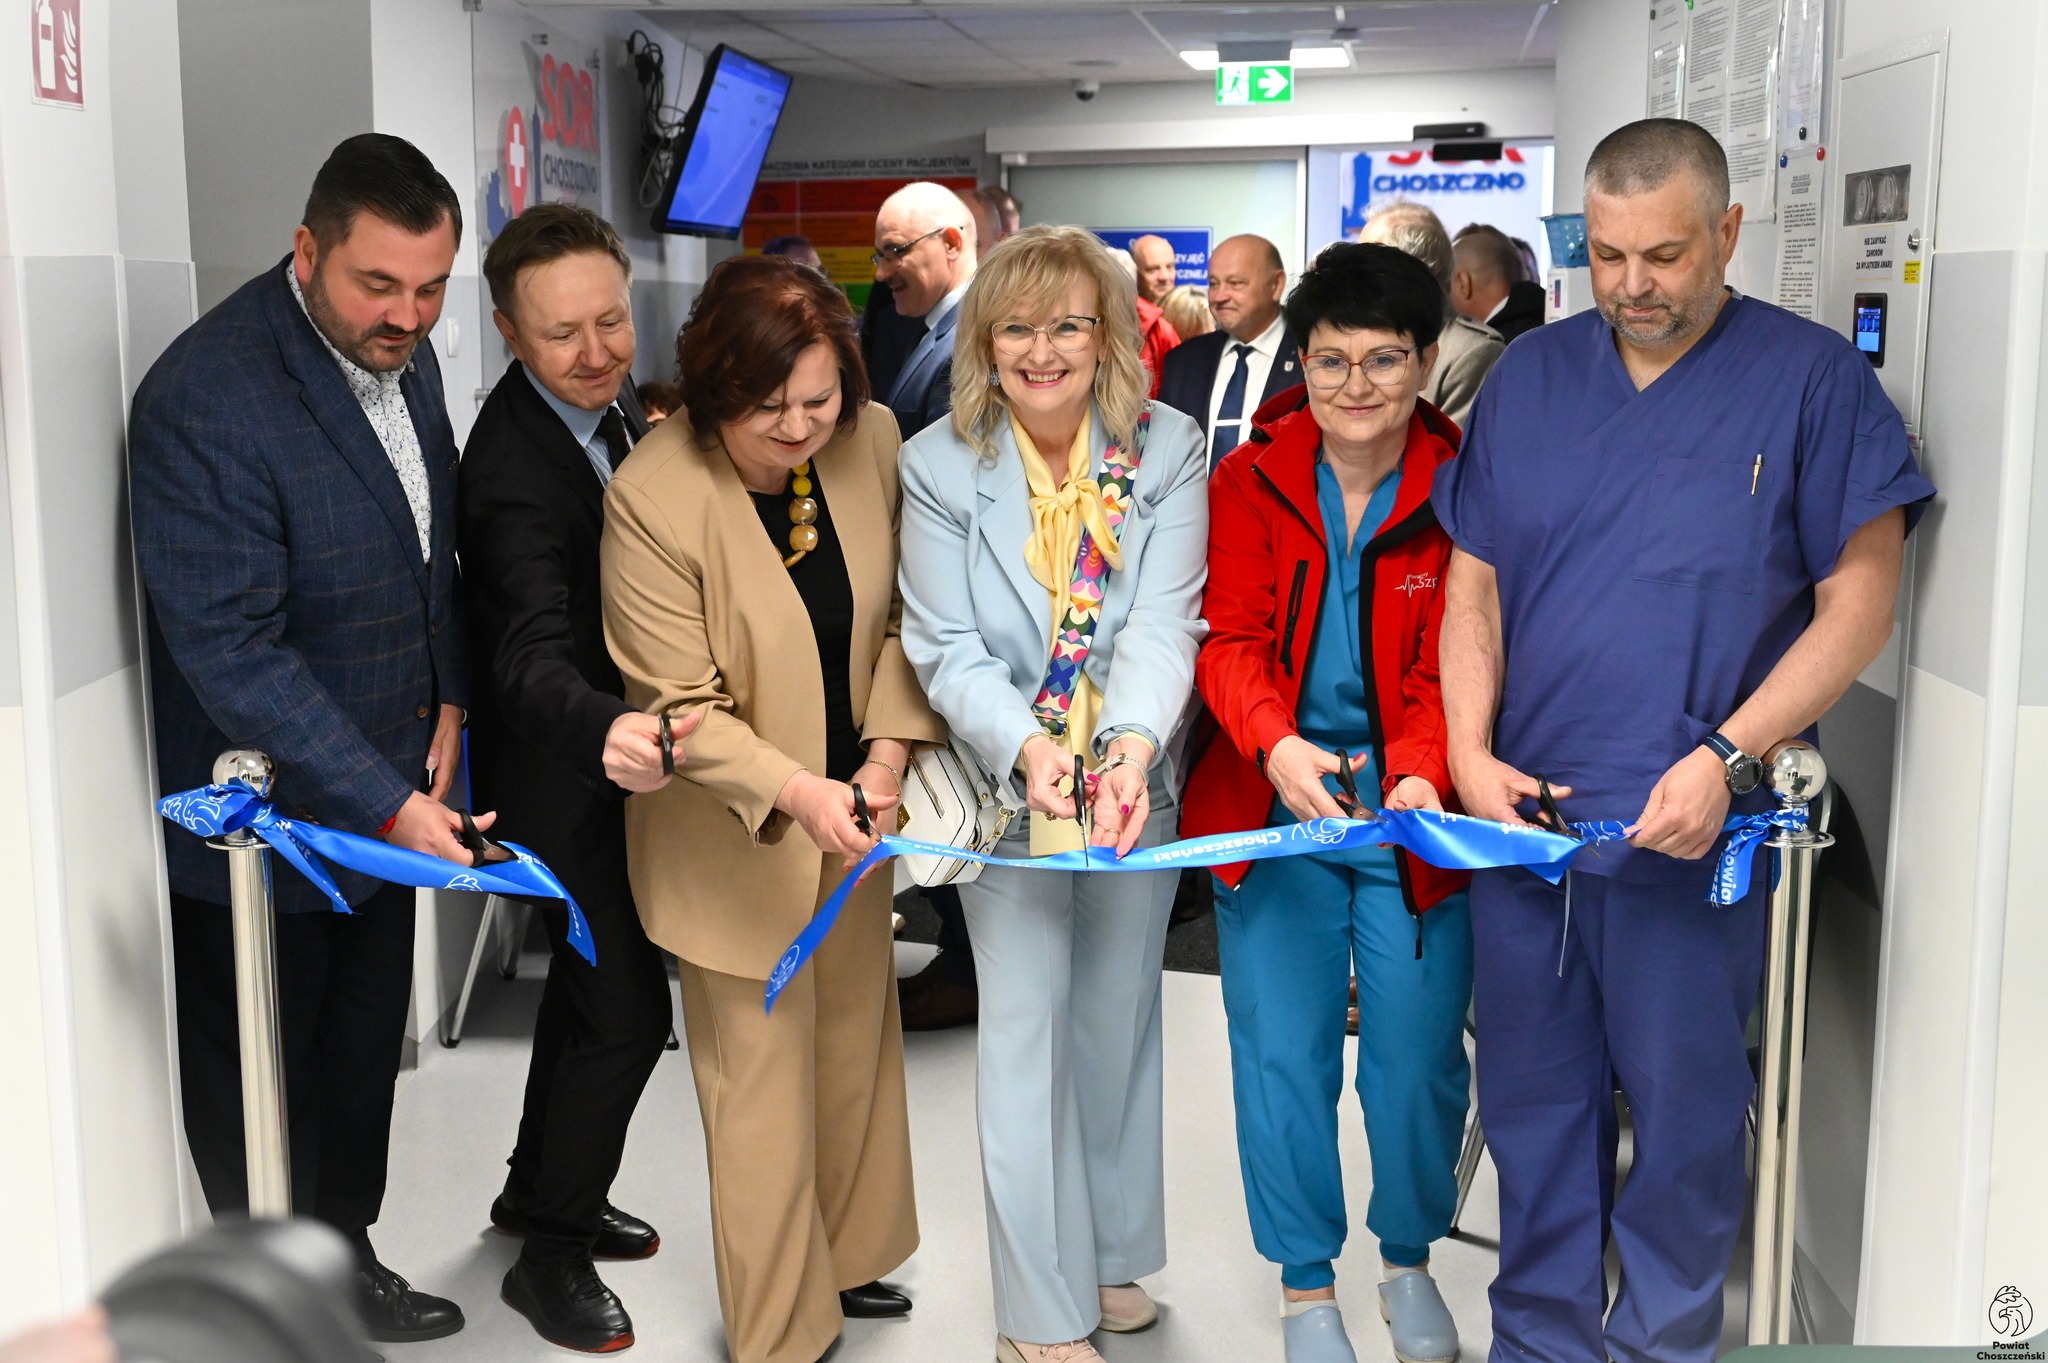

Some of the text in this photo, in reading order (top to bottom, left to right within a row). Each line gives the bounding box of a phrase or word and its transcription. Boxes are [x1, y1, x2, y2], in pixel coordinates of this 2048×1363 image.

[542, 53, 596, 153] SOR
[1373, 173, 1525, 192] CHOSZCZNO
[1153, 831, 1282, 863] Choszczeński
